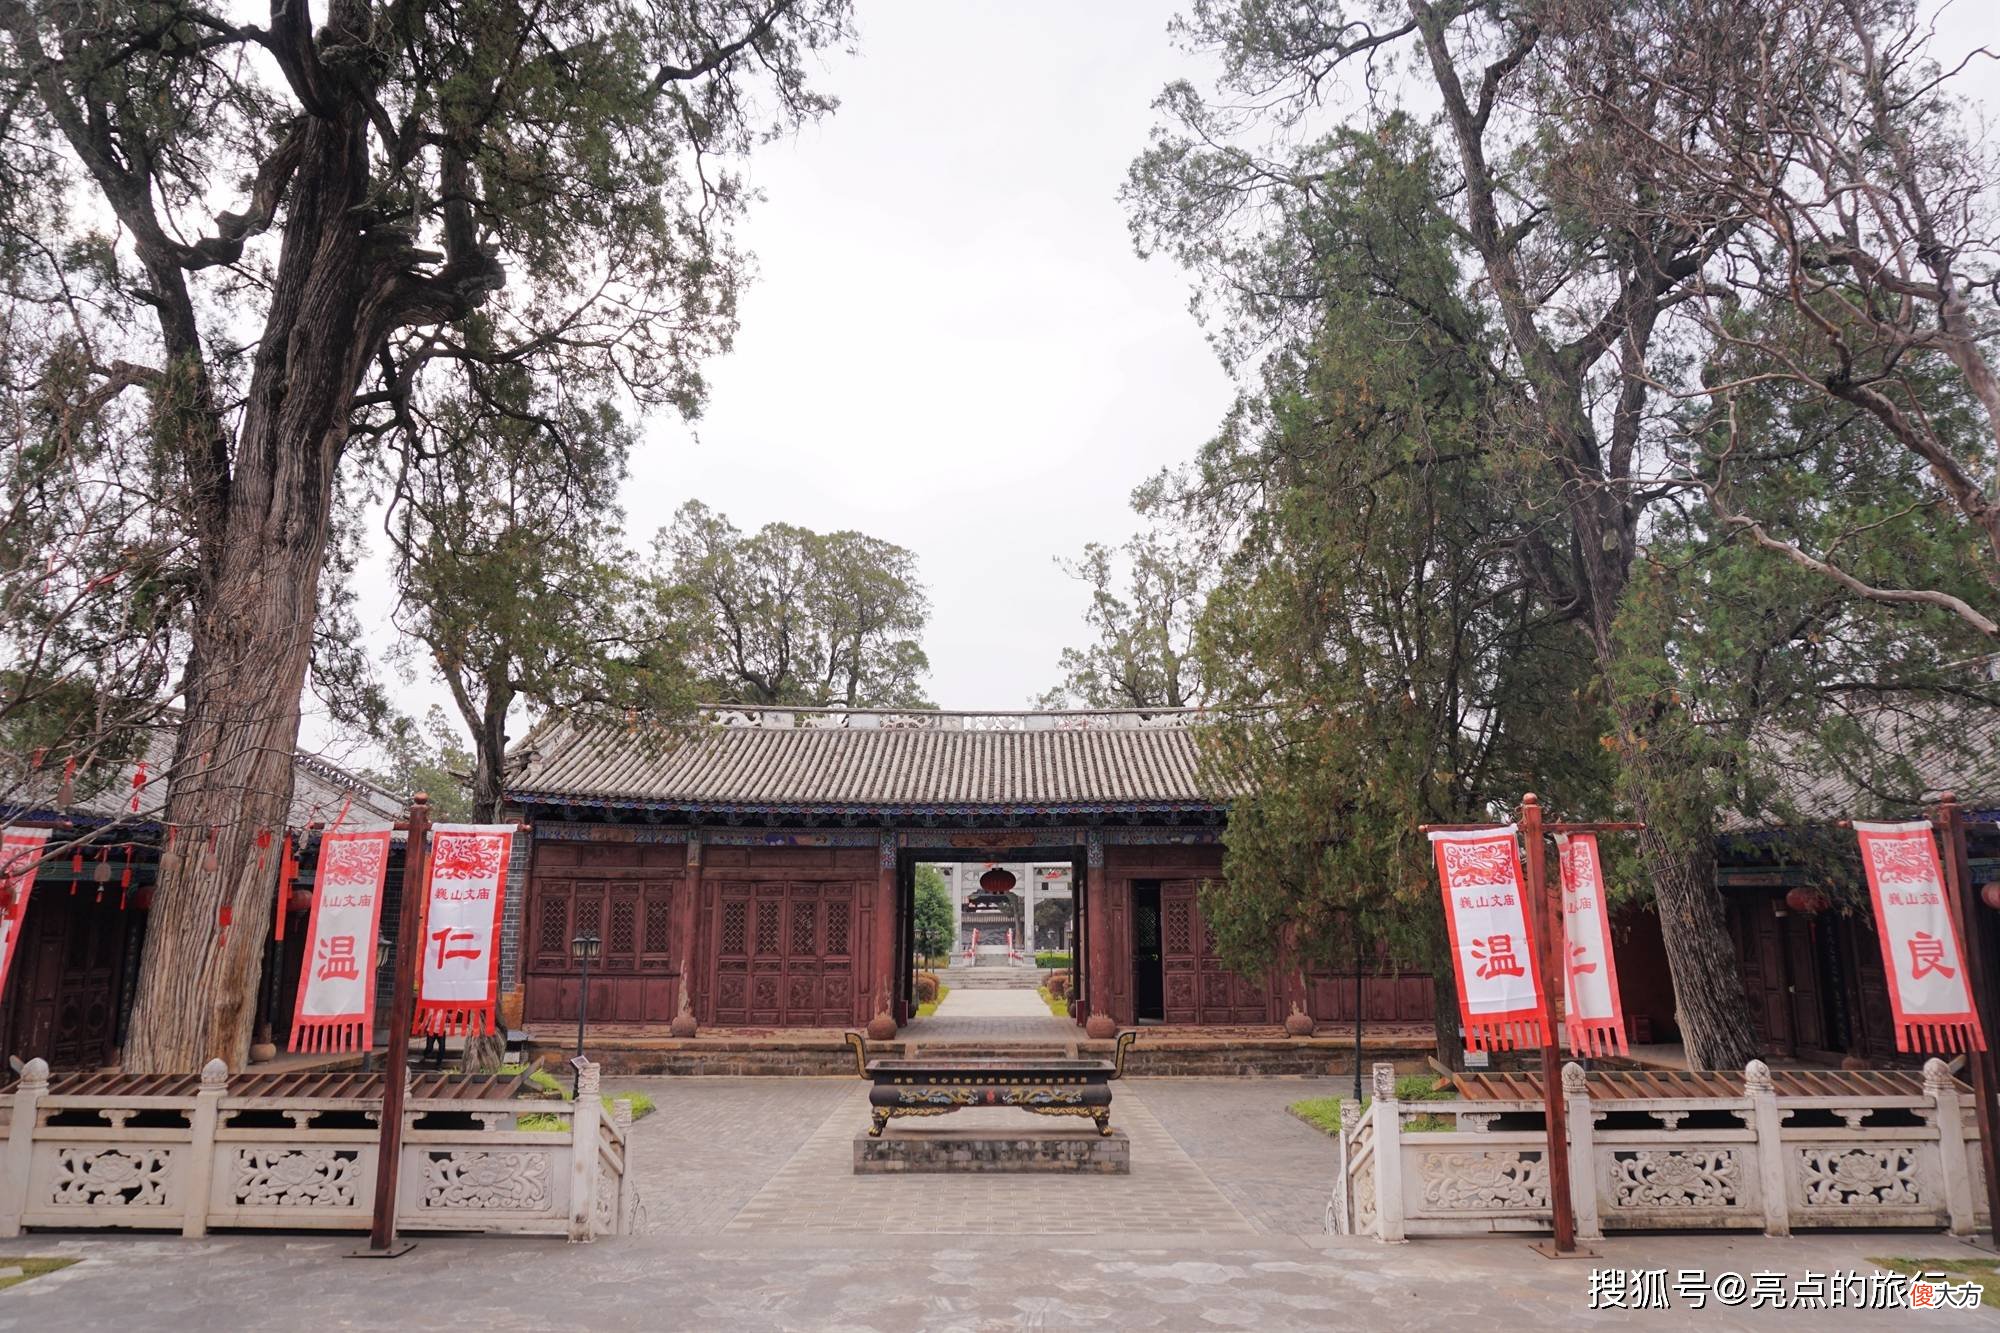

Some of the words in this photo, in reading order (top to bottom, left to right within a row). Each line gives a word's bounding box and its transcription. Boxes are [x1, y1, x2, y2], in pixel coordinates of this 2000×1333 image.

[434, 888, 491, 901] 巍山文庙
[1460, 894, 1515, 909] 巍山文庙
[317, 936, 359, 981] 温
[432, 928, 482, 970] 仁
[1471, 934, 1525, 980] 温
[1907, 931, 1955, 980] 良
